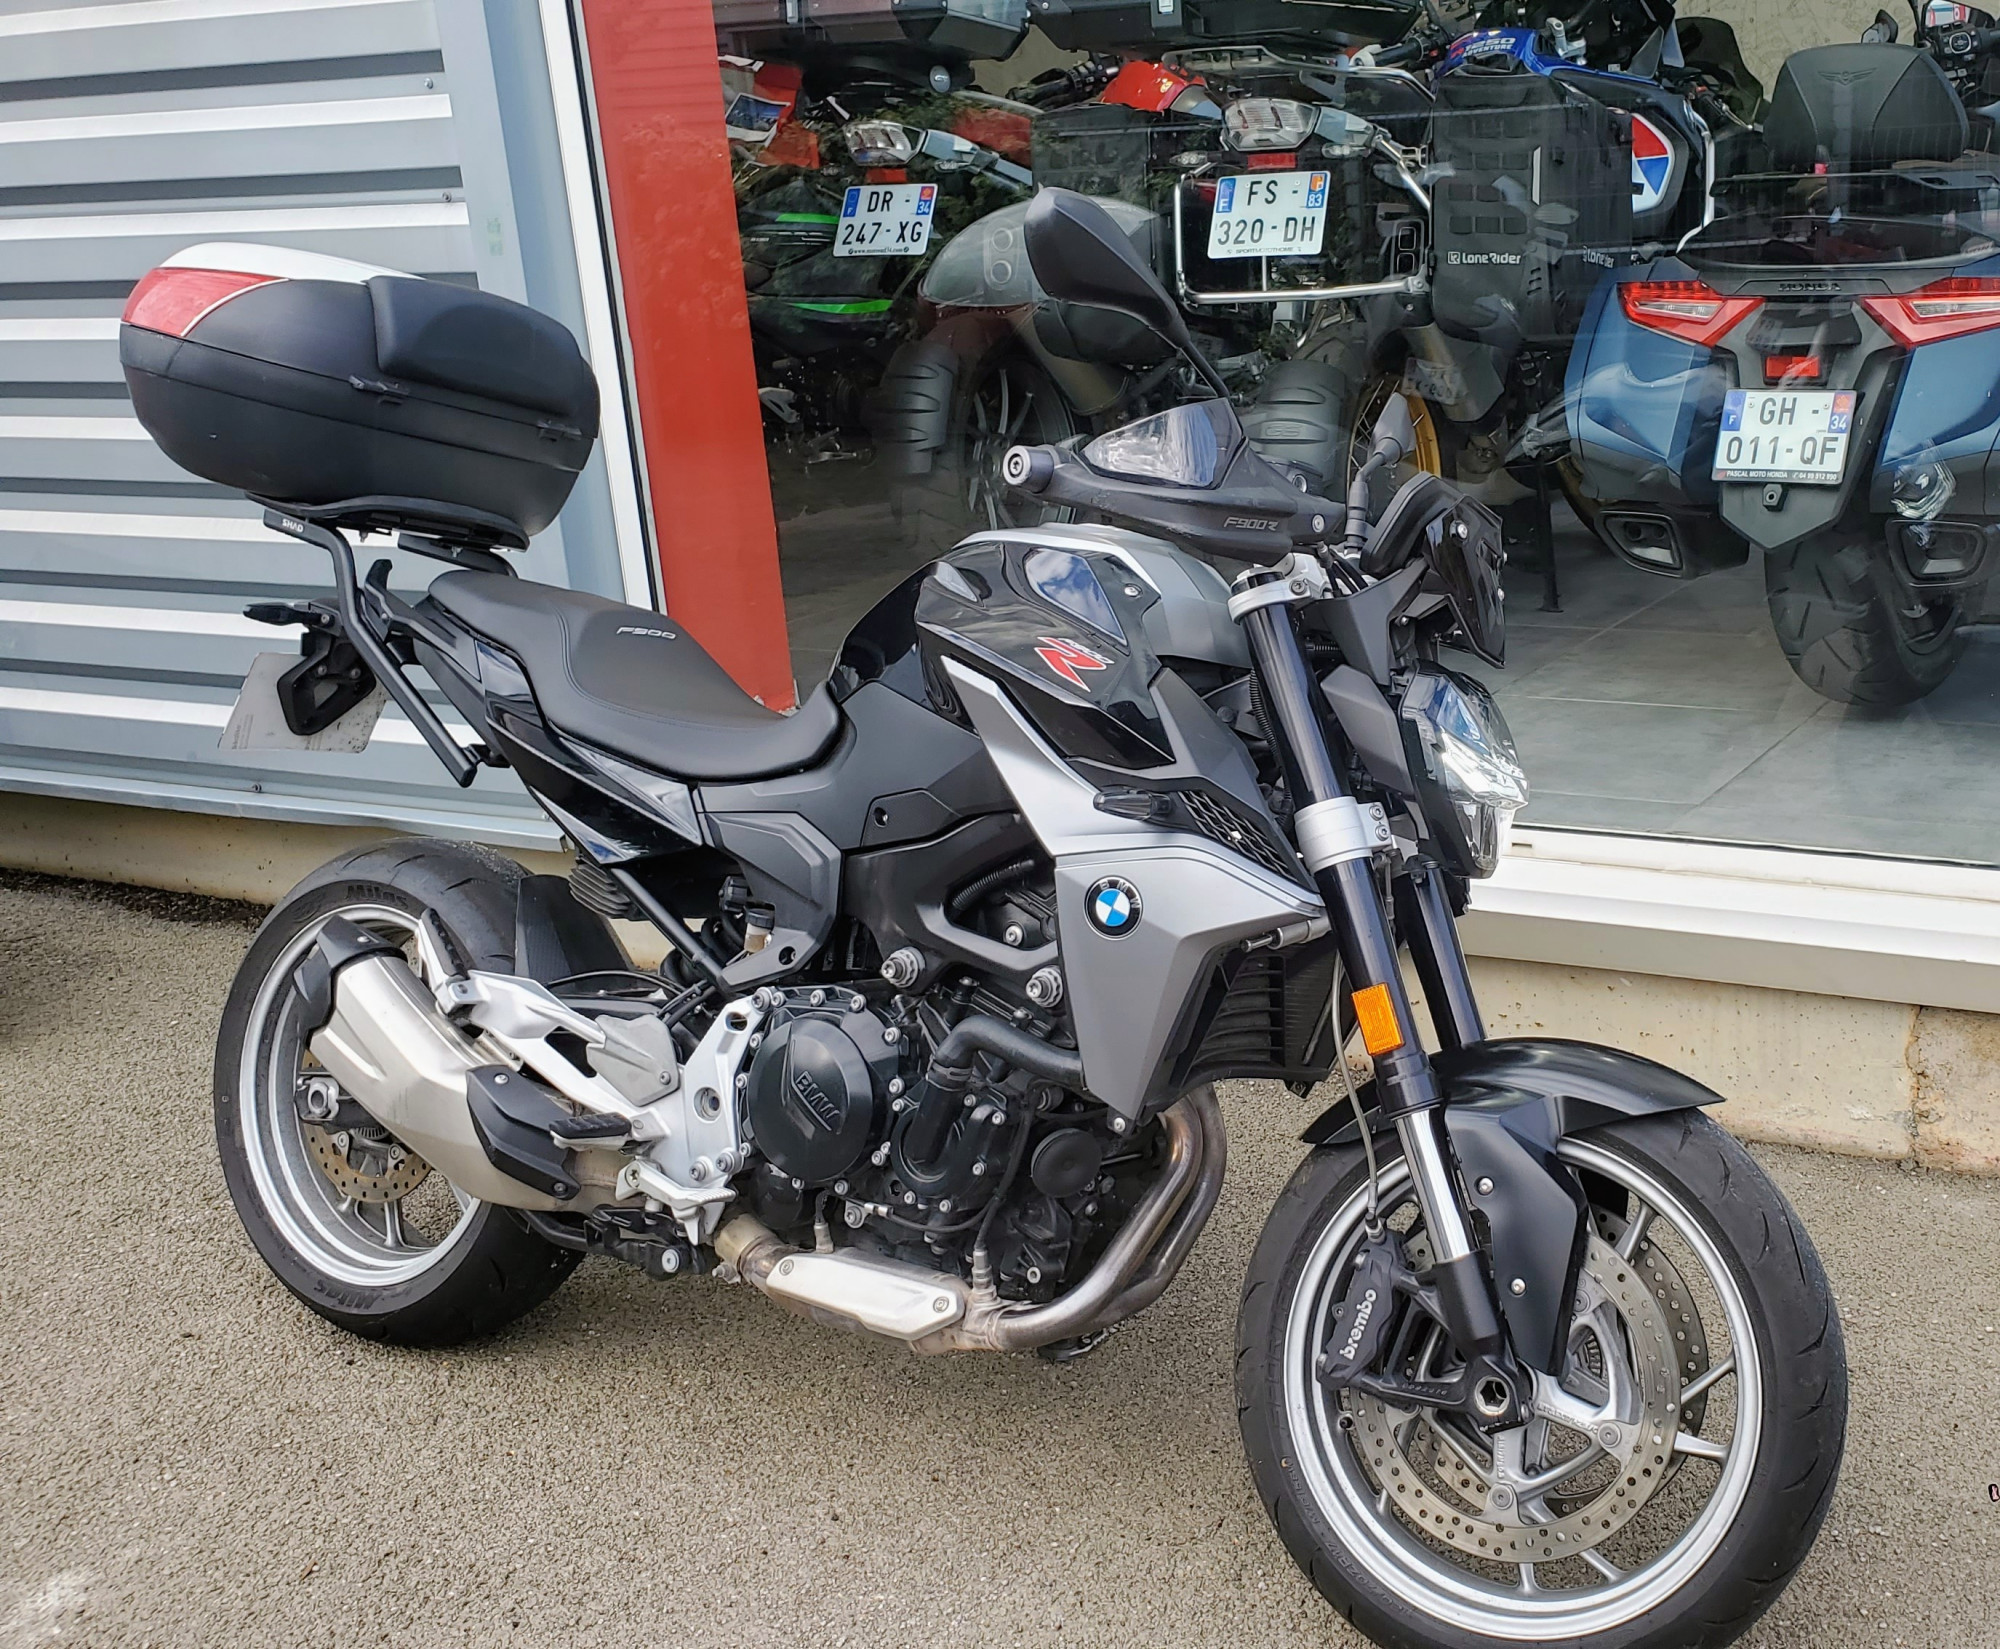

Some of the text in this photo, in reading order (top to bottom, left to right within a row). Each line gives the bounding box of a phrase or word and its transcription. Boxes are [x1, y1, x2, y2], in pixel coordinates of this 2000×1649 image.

[1247, 180, 1278, 206] FS
[1308, 193, 1322, 207] 83
[867, 191, 893, 212] DR
[917, 201, 930, 214] 34
[847, 207, 854, 215] F
[1778, 283, 1841, 291] HONDA
[1760, 397, 1797, 425] GH
[1728, 415, 1736, 425] F
[1830, 415, 1847, 430] 34
[282, 518, 304, 533] SHAD
[616, 627, 676, 640] F900
[796, 1070, 840, 1119] BMW
[1339, 1289, 1377, 1360] brembo
